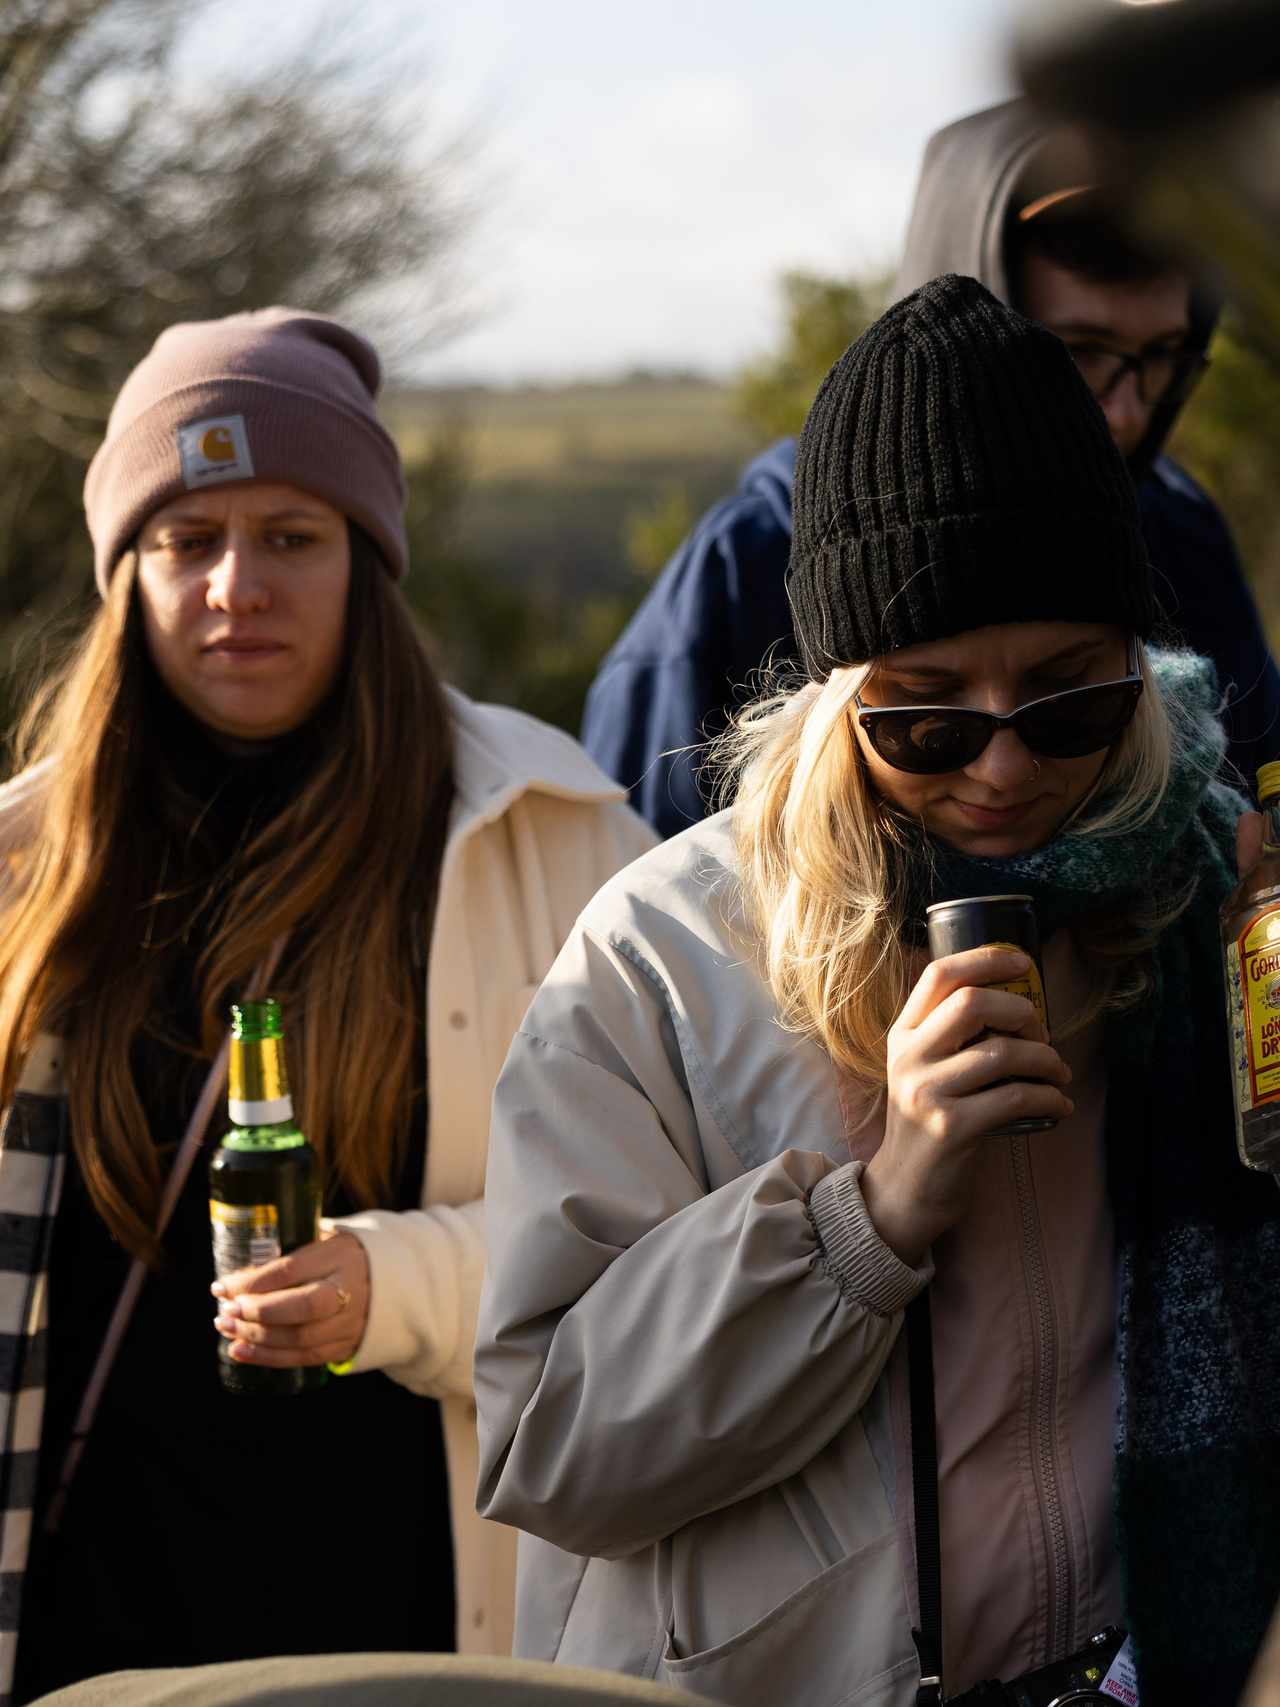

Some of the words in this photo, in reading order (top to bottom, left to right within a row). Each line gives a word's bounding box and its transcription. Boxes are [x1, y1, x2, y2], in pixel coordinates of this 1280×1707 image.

[1119, 1678, 1134, 1690] CHINA
[1120, 1672, 1133, 1682] MADE
[1105, 1683, 1123, 1698] FROM
[1122, 1694, 1137, 1707] FIRE
[1107, 1677, 1123, 1690] KEEP
[1122, 1687, 1139, 1701] AWAY
